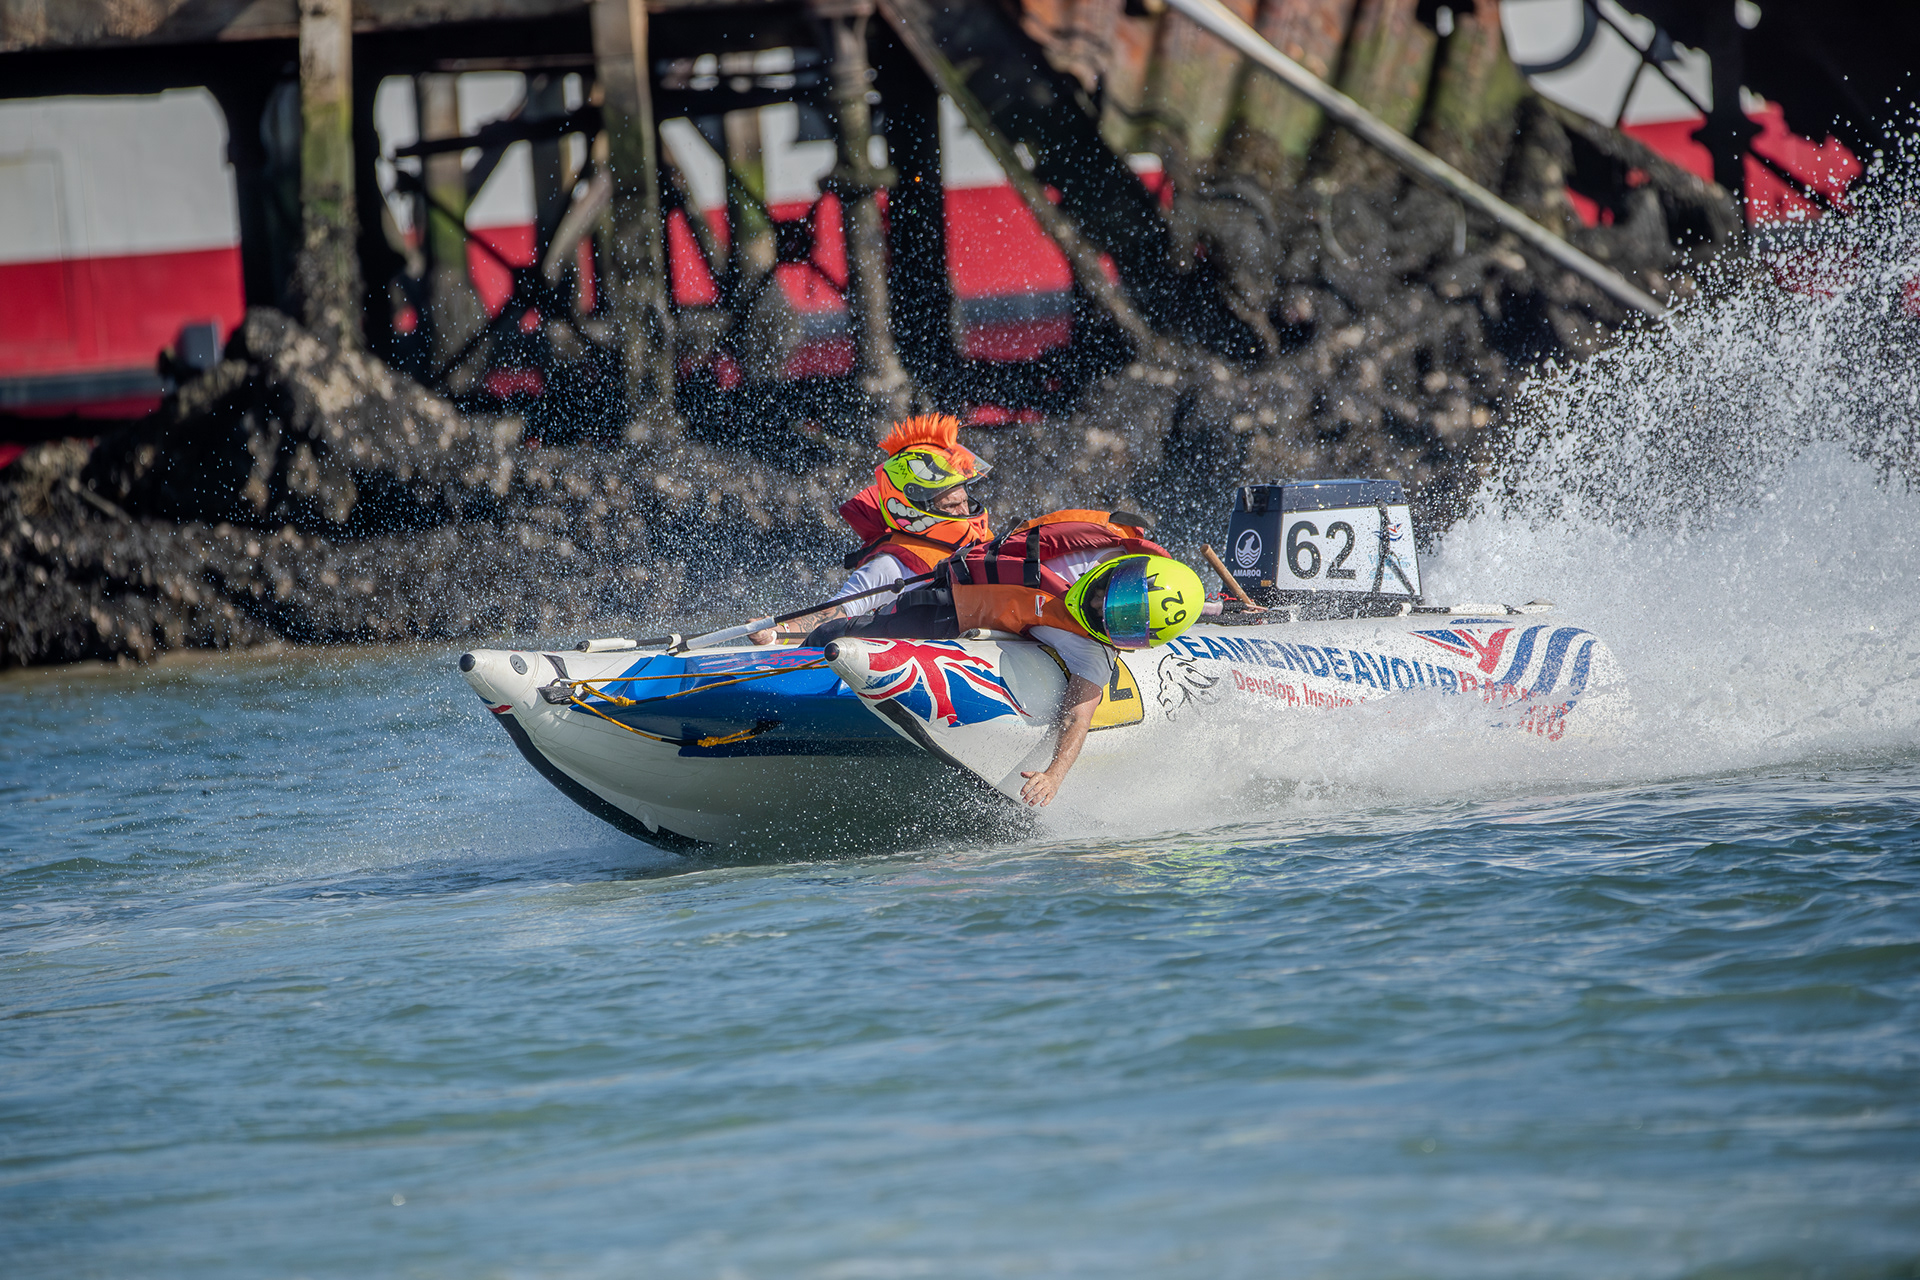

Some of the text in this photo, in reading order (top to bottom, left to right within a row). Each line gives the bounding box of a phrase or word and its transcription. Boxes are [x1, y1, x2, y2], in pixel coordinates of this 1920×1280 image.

[1286, 520, 1356, 580] 62
[1232, 568, 1262, 578] AMAROQ
[1161, 591, 1187, 626] 62
